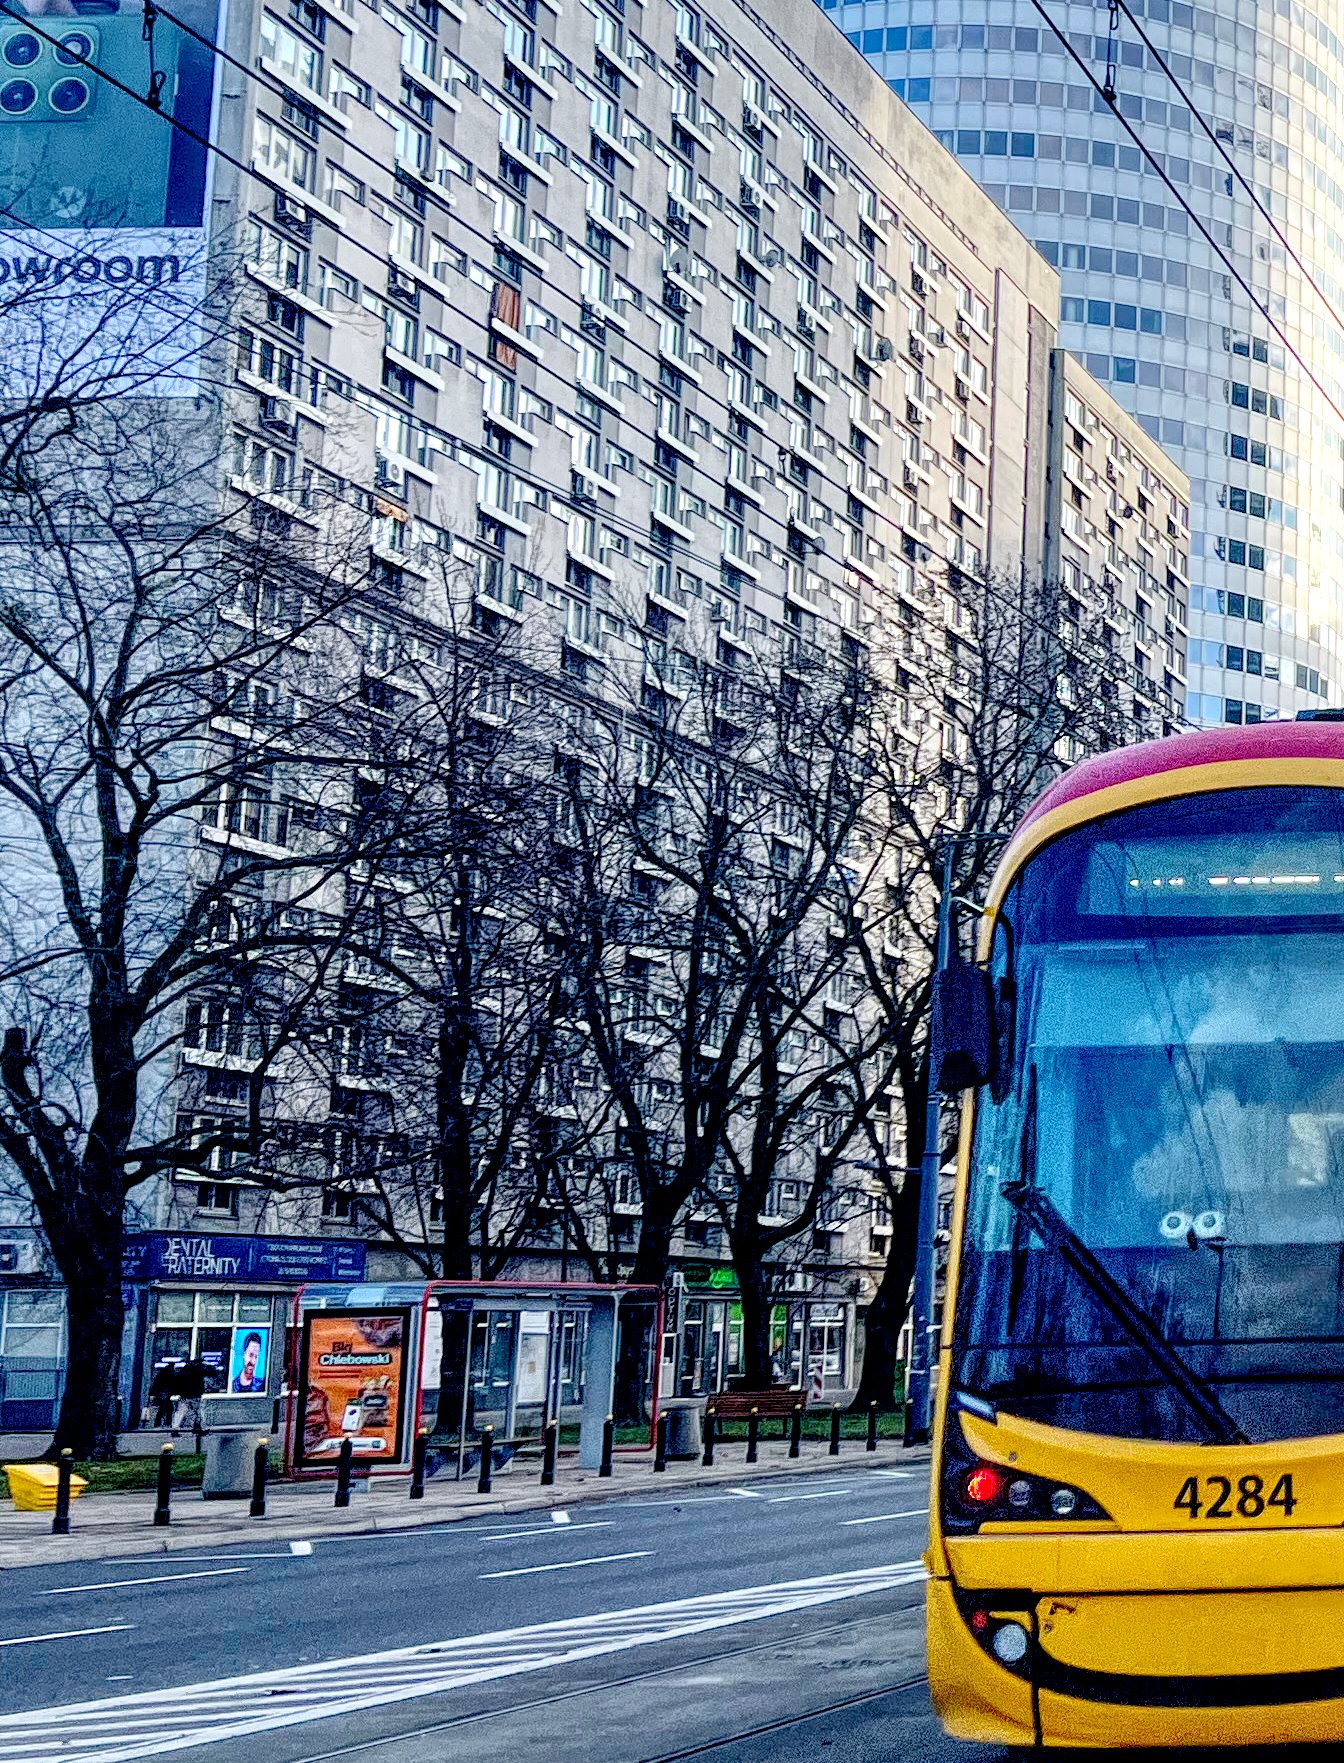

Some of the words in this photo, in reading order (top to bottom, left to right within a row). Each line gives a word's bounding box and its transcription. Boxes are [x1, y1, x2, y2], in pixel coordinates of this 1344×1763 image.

[165, 1237, 216, 1257] DENTAL
[162, 1254, 241, 1276] FRATERNITY
[320, 1353, 391, 1366] Chlebowski
[1173, 1473, 1298, 1519] 4284
